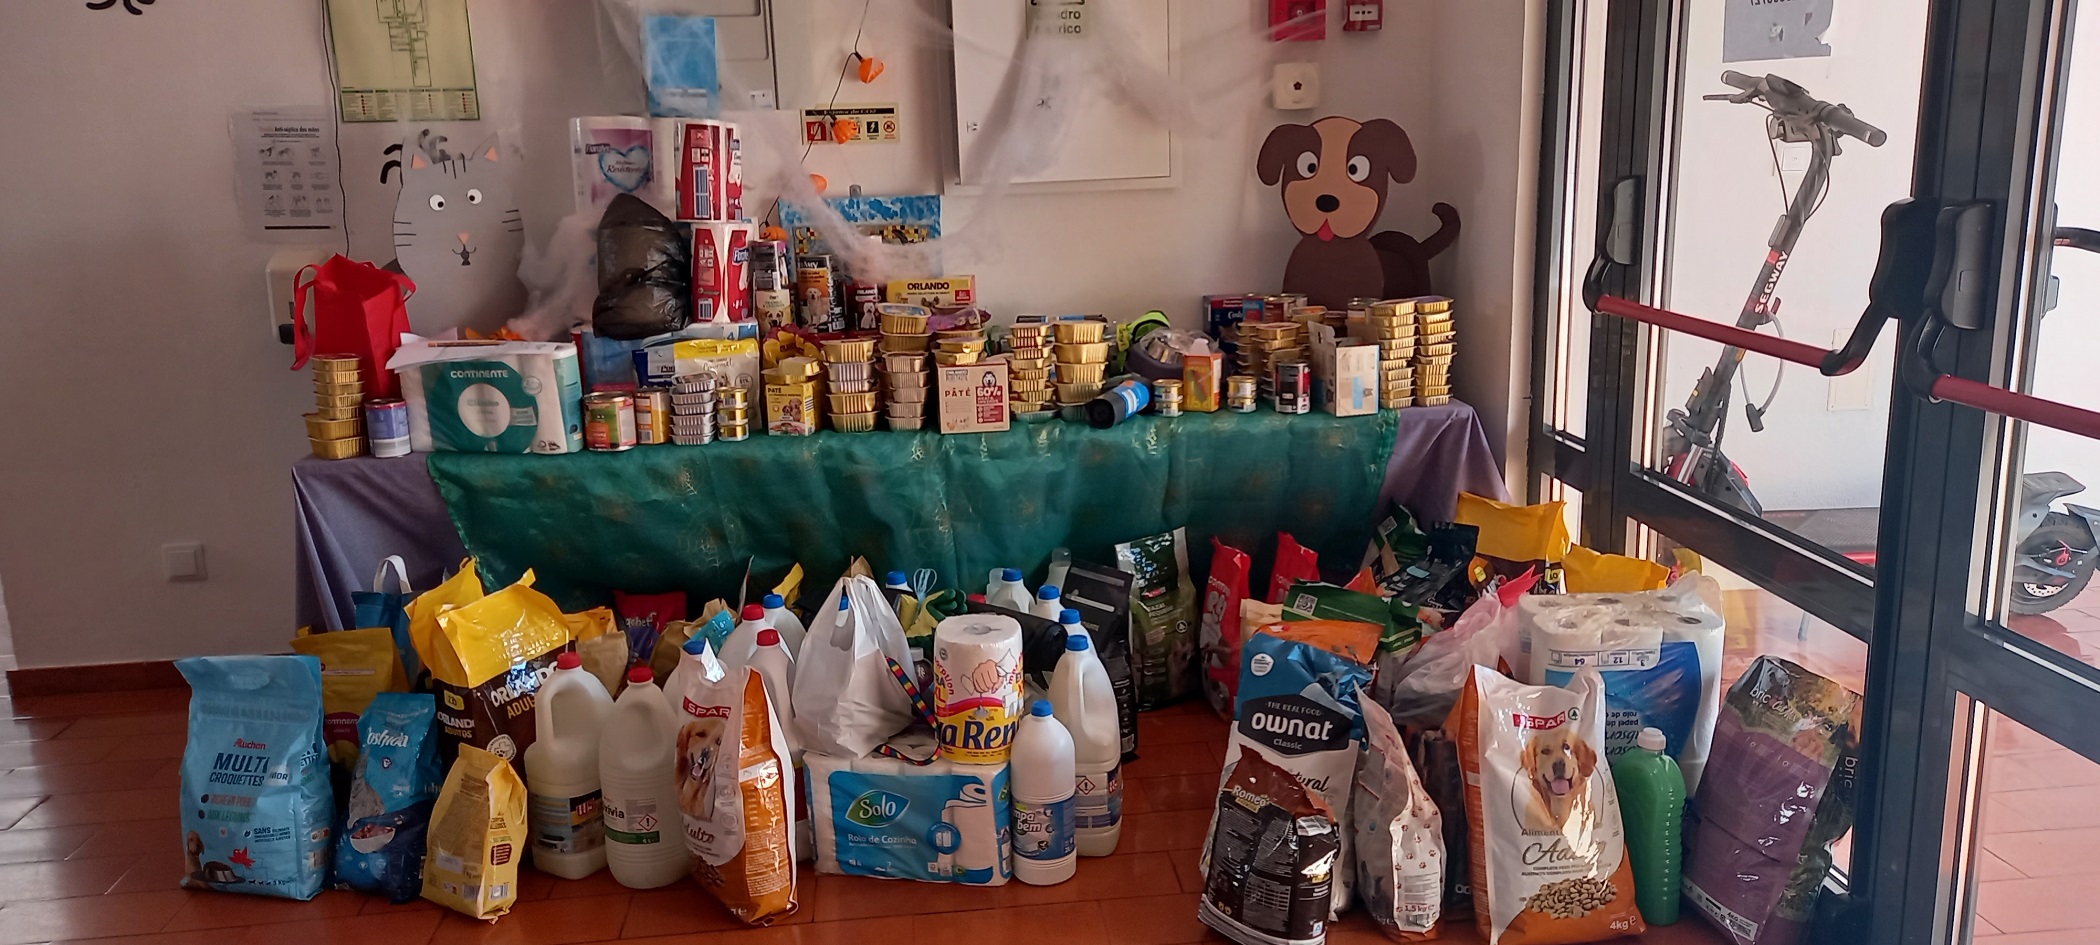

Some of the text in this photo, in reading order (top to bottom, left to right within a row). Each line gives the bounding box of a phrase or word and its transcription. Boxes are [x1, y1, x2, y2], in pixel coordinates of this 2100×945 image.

[907, 282, 950, 291] ORLANDO
[1754, 250, 1789, 314] SEGWAY
[450, 370, 509, 379] CONTINENTE
[945, 387, 971, 398] PÂTÉ
[1574, 657, 1586, 666] 64
[1613, 656, 1624, 664] 12
[1749, 682, 1772, 704] bric
[507, 696, 536, 719] ADUL
[687, 702, 730, 717] SPAR
[1283, 703, 1300, 713] REAL
[1301, 706, 1322, 717] FOOD
[1611, 711, 1620, 719] de
[1251, 712, 1334, 741] ownat
[1523, 714, 1566, 729] SPAR
[1618, 718, 1639, 728] papel
[234, 738, 266, 750] Auchan
[1273, 738, 1303, 750] Classic
[1844, 756, 1859, 789] bric
[209, 771, 265, 787] CROQUETTES
[859, 794, 895, 819] Solo
[254, 827, 271, 835] SANS
[1017, 821, 1042, 833] bem
[868, 835, 880, 844] de
[881, 835, 918, 845] Cozinha
[1609, 920, 1629, 931] 4kg
